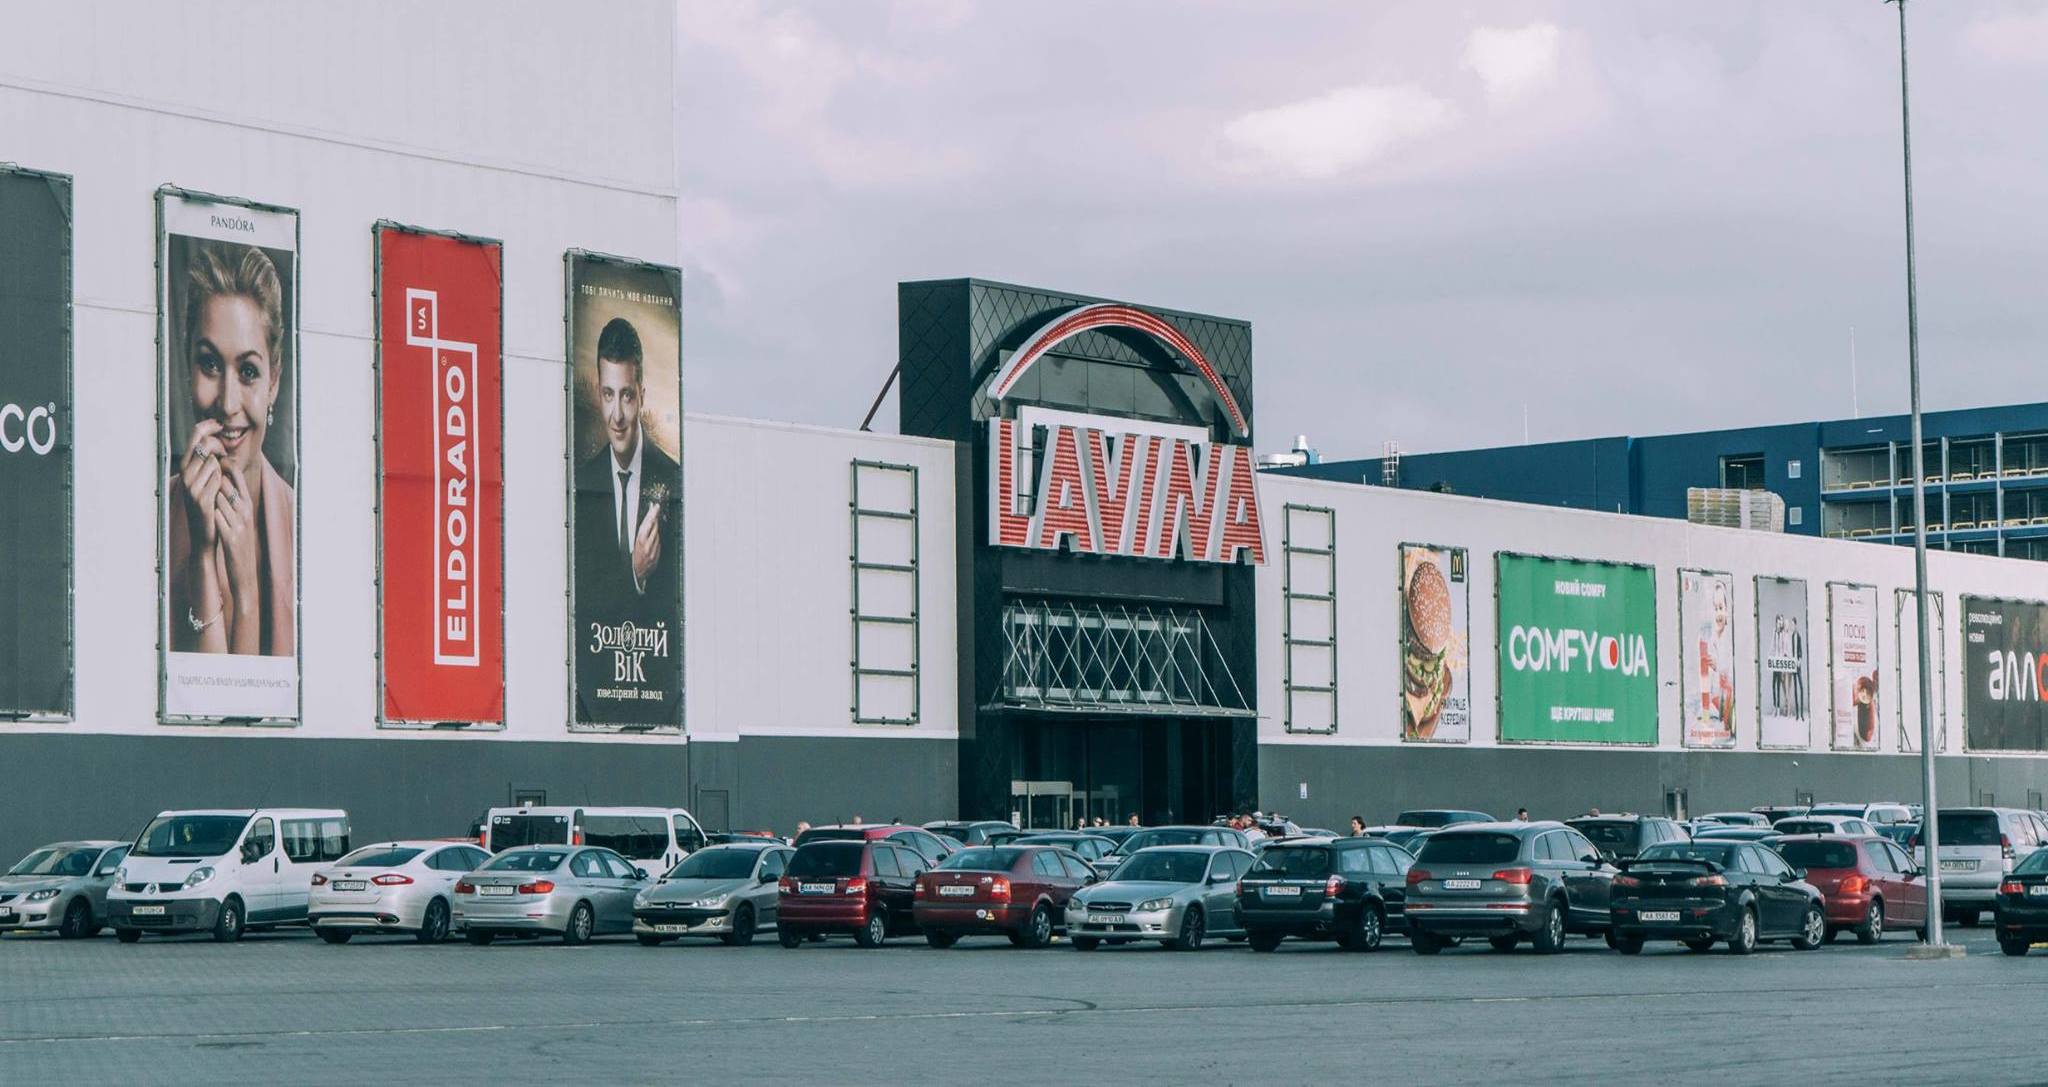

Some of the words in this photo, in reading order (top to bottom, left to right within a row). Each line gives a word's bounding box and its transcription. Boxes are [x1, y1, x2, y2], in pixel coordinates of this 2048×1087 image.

[417, 306, 426, 331] UA
[988, 416, 1270, 566] LAVINA
[445, 365, 468, 642] ELDORADO
[1581, 582, 1607, 598] COMFY
[1767, 658, 1796, 670] BLESSED
[596, 685, 638, 701] ювелірний
[640, 689, 663, 700] завод
